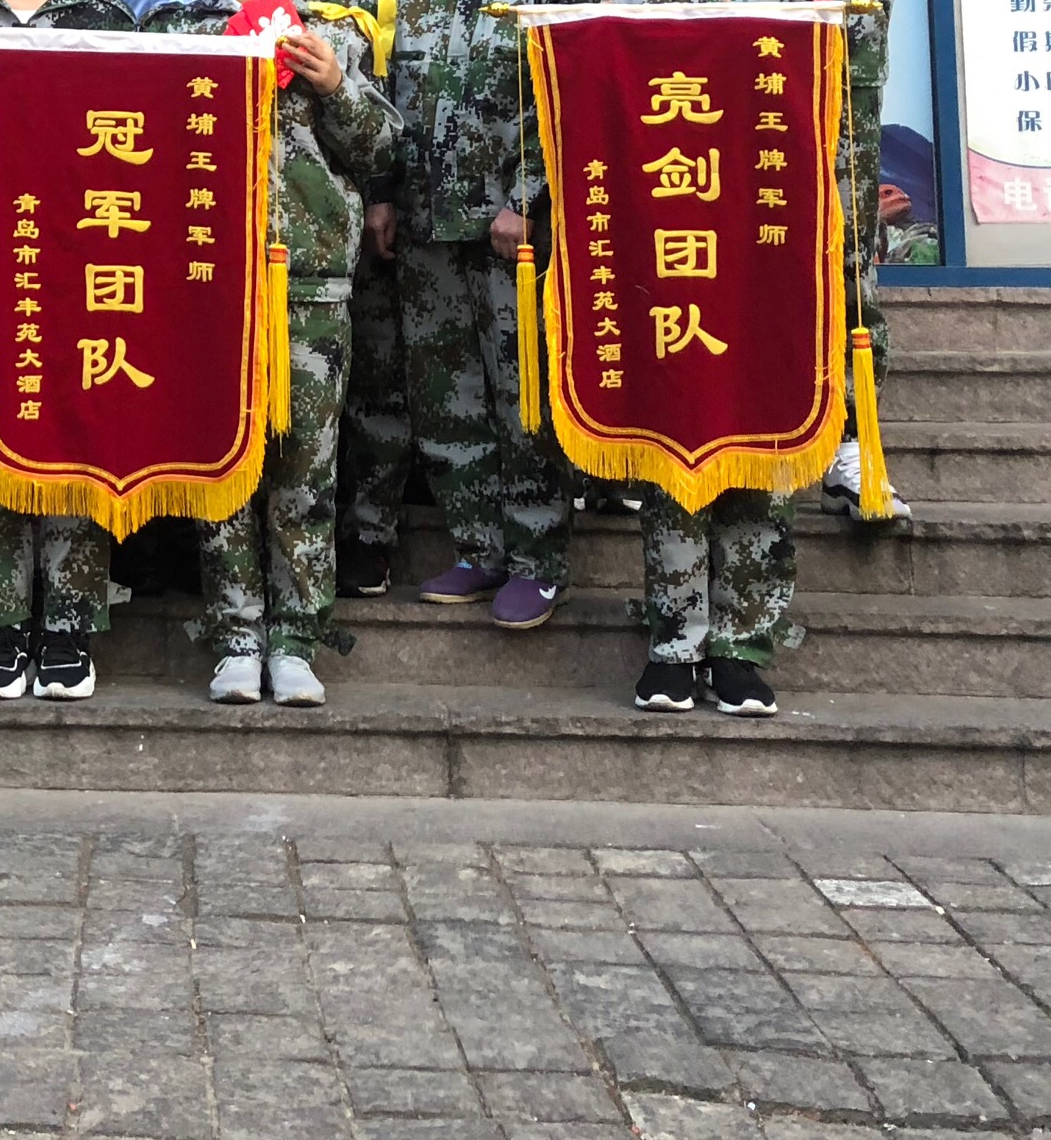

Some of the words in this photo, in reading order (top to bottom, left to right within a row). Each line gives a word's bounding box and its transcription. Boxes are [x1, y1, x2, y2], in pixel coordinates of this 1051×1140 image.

[753, 36, 789, 246] 黄埔王牌军师
[1013, 30, 1051, 53] 假
[1014, 70, 1051, 92] 小
[1017, 110, 1042, 132] 保
[76, 110, 155, 390] 冠军团队
[185, 76, 219, 282] 黄埔王牌军师
[583, 159, 625, 389] 青岛市汇丰苑大酒店
[640, 71, 729, 360] 亮剑团队
[1003, 176, 1051, 212] 电
[13, 192, 44, 421] 青岛市汇丰苑大酒店
